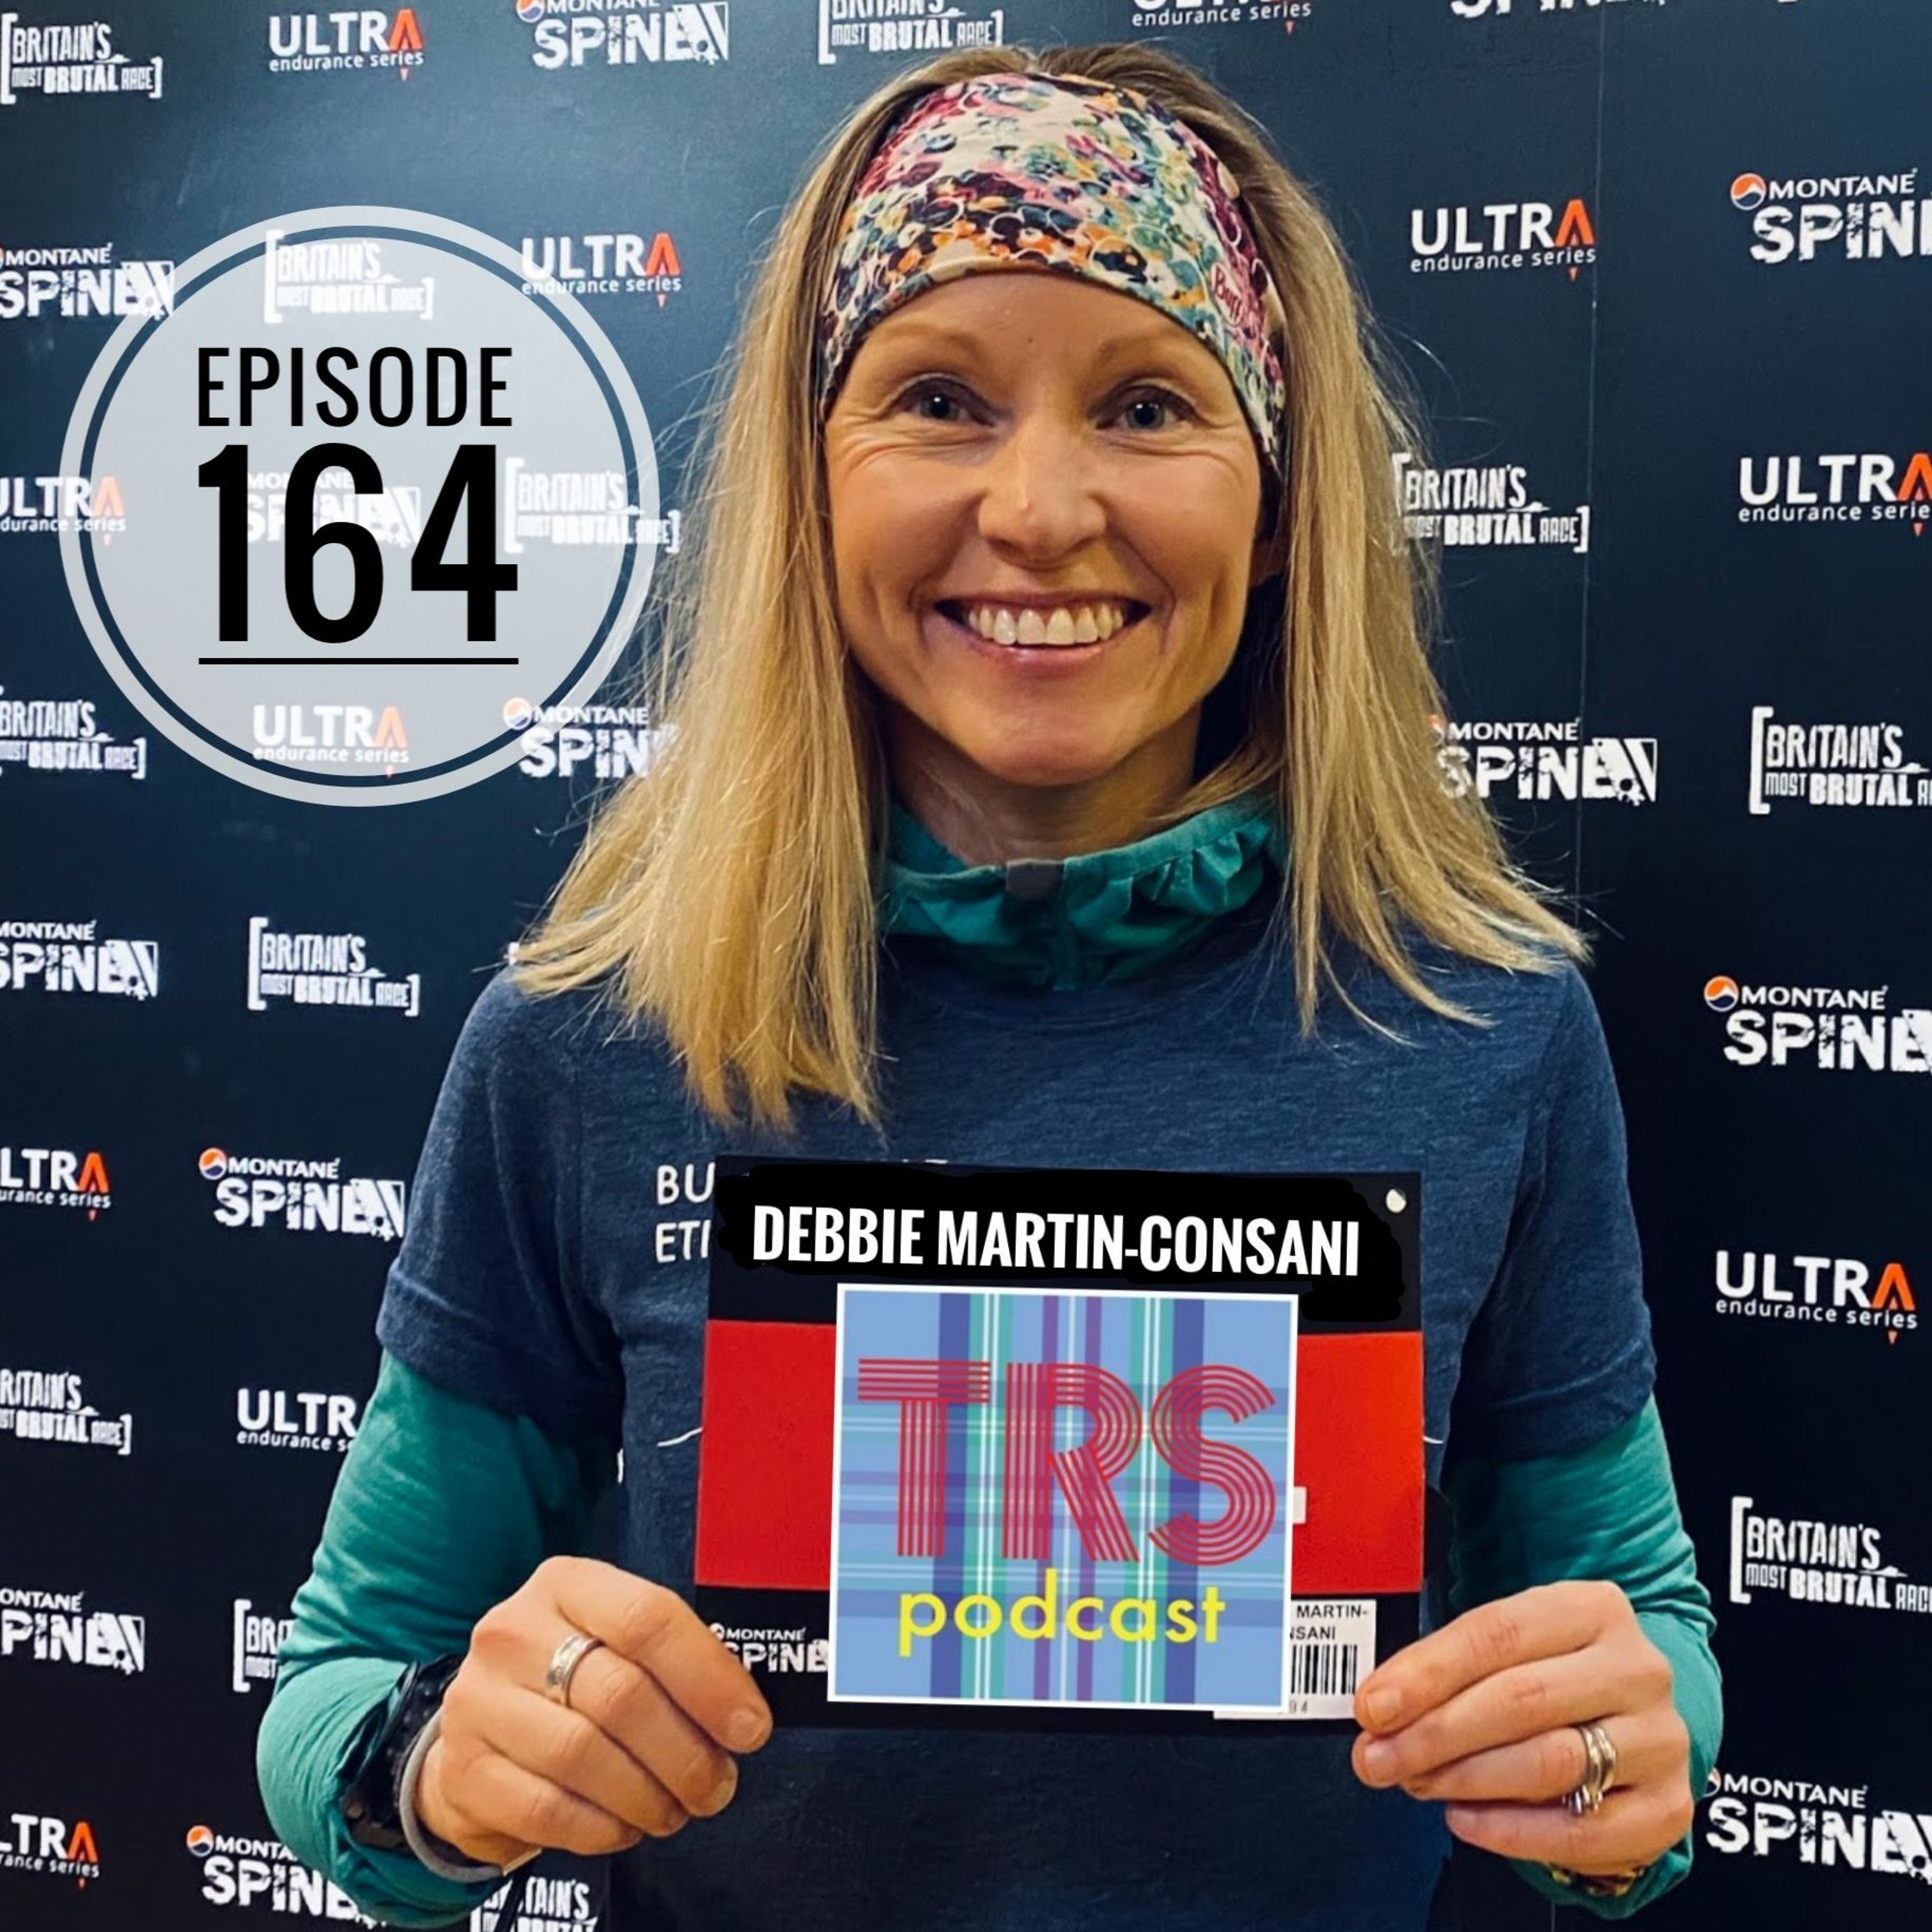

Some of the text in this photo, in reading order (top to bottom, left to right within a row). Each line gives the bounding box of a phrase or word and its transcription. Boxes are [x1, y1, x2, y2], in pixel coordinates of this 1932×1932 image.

[1132, 9, 1242, 26] endurance
[1249, 2, 1312, 20] series
[13, 23, 111, 63] BRITAIN'S
[269, 8, 424, 57] ULTRA
[532, 12, 697, 69] SPINE
[869, 19, 952, 52] BRUTAL
[957, 21, 993, 47] RACE
[269, 50, 425, 72] endurance series
[43, 66, 119, 93] BRUTAL
[1411, 199, 1595, 254] ULTRA
[522, 232, 681, 280] ULTRA
[1410, 247, 1596, 273] endurance series
[310, 285, 388, 313] BRUTAL
[522, 276, 681, 295] endurance series
[518, 471, 625, 512] BRITAIN'S
[1406, 464, 1527, 510] BRITAIN'S
[1739, 453, 1932, 505] ULTRA
[73, 515, 126, 532] series
[1443, 513, 1535, 545] BRUTAL
[1539, 516, 1579, 544] RACE
[1739, 503, 1862, 522] endurance
[552, 515, 634, 544] BRUTAL
[253, 705, 408, 750] ULTRA
[28, 741, 103, 770] BRUTAL
[252, 744, 410, 764] endurance series
[1766, 722, 1904, 769] BRITAIN'S
[1765, 772, 1807, 796] MOST
[1809, 773, 1913, 806] BRUTAL
[261, 933, 366, 973] BRITAIN'S
[294, 974, 374, 1007] BRUTAL
[1723, 1009, 1932, 1074] SPINE
[59, 1193, 111, 1209] series
[214, 1178, 376, 1235] SPINE
[1716, 1250, 1915, 1311] ULTRA
[1716, 1298, 1917, 1330] endurance series
[237, 1387, 357, 1437] ULTR
[236, 1429, 332, 1452] endurance
[1746, 1515, 1880, 1571] BRITAIN'S
[1746, 1562, 1787, 1590] MOST
[1789, 1567, 1891, 1610] BRUTAL
[1296, 1604, 1368, 1618] MARTIN-
[724, 1639, 829, 1672] PINE
[215, 1835, 298, 1862] MONTA
[1706, 1797, 1911, 1875] SPINE
[49, 1859, 100, 1879] series
